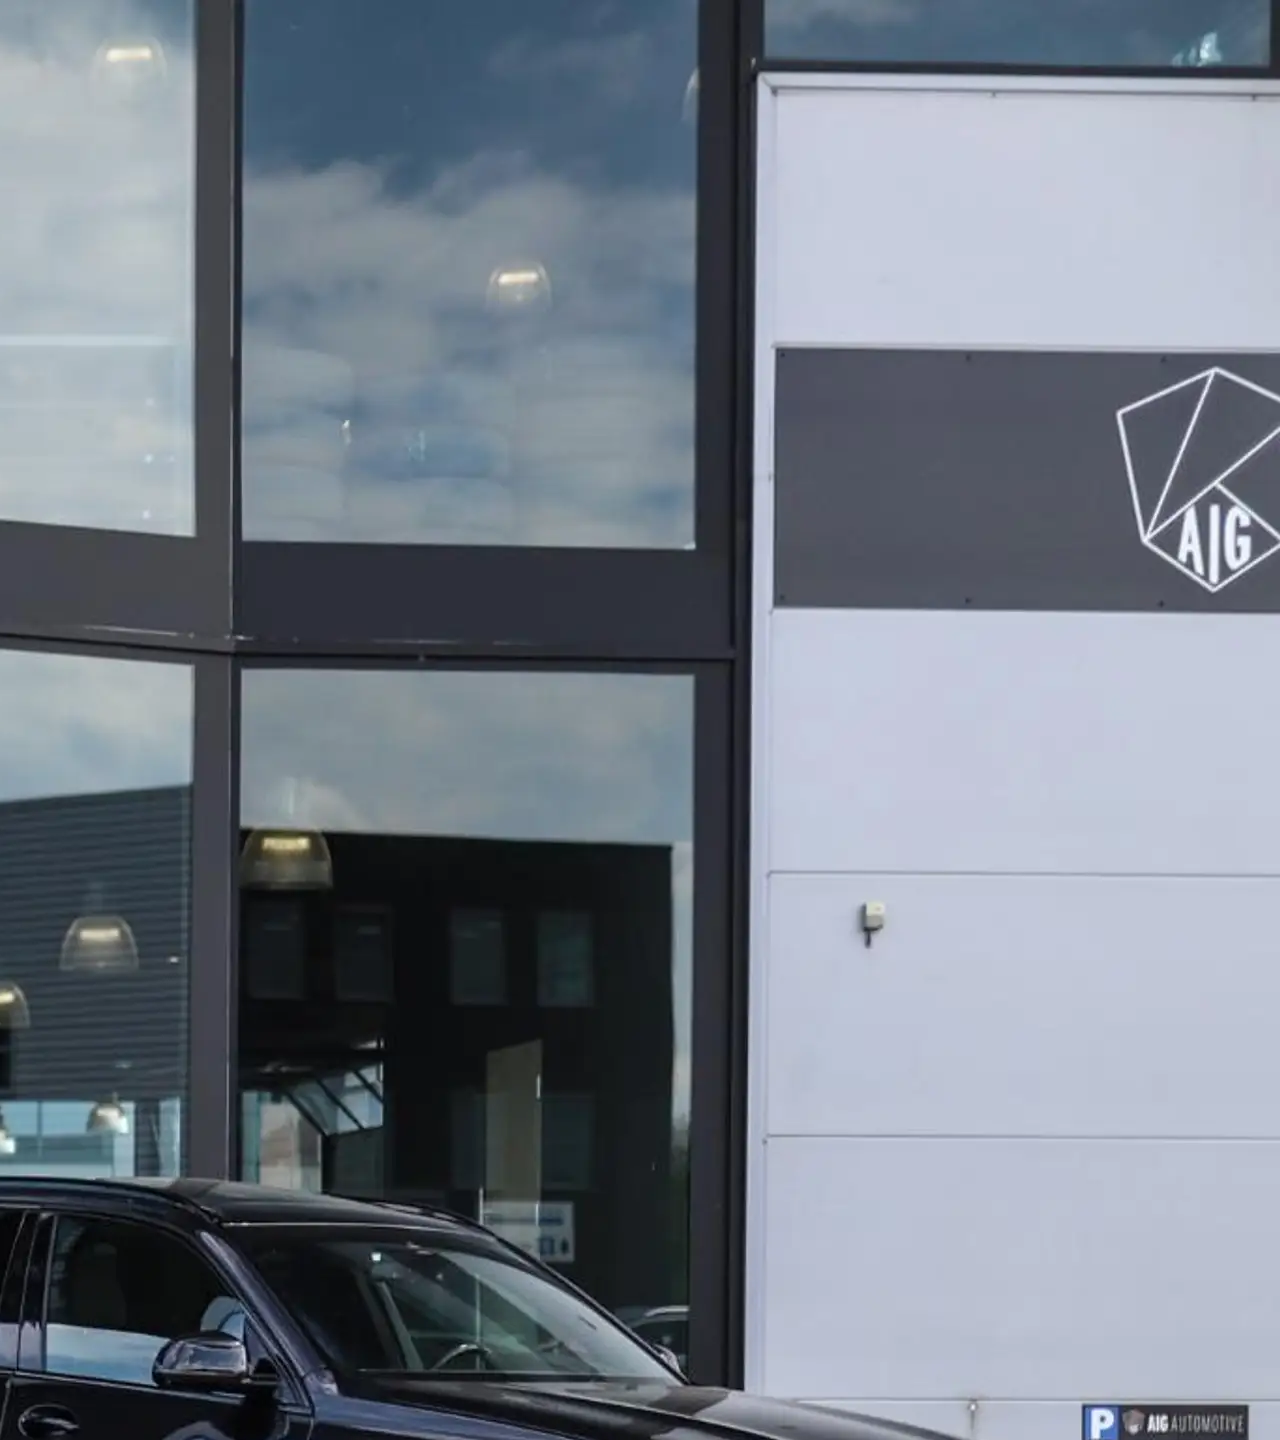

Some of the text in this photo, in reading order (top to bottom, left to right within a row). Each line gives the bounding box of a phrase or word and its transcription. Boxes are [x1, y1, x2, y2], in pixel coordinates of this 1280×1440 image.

[1177, 503, 1252, 584] AIG
[1090, 1408, 1115, 1440] P
[1147, 1413, 1169, 1433] AIG
[1170, 1414, 1245, 1434] AUTOMOTIVE
